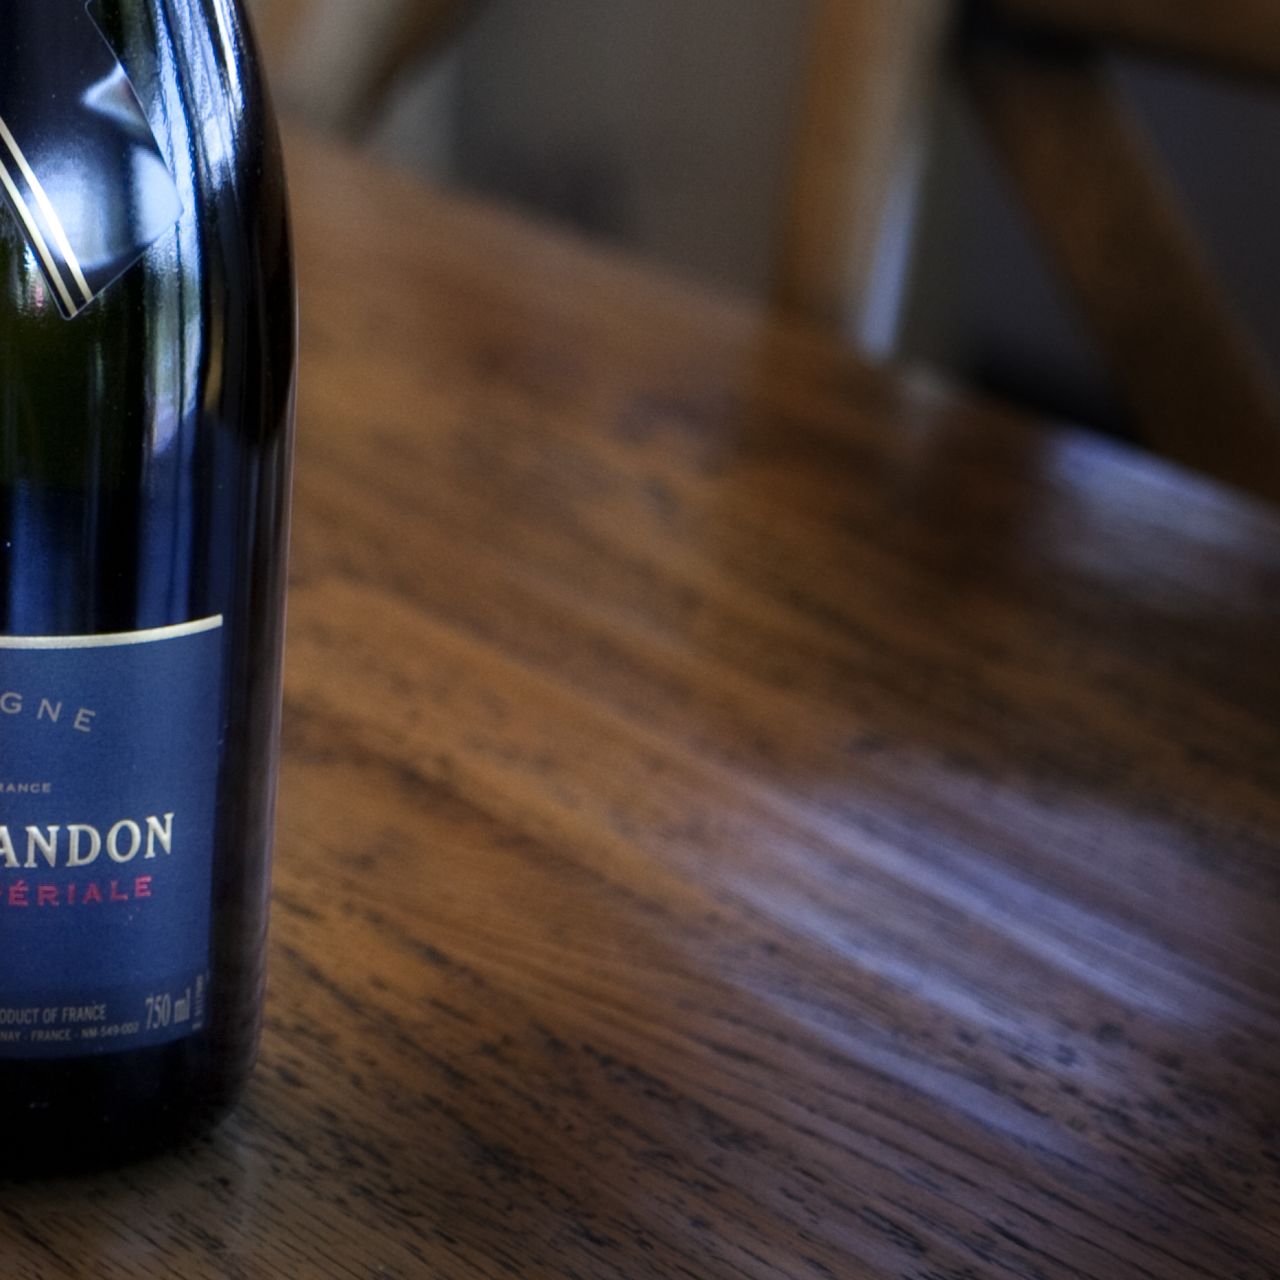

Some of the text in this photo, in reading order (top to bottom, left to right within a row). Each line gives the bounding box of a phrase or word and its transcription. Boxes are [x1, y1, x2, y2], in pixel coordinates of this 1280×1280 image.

[42, 1006, 58, 1024] OF
[61, 1003, 107, 1022] FRANCE
[145, 992, 170, 1031] 750
[31, 1027, 72, 1042] FRANCE
